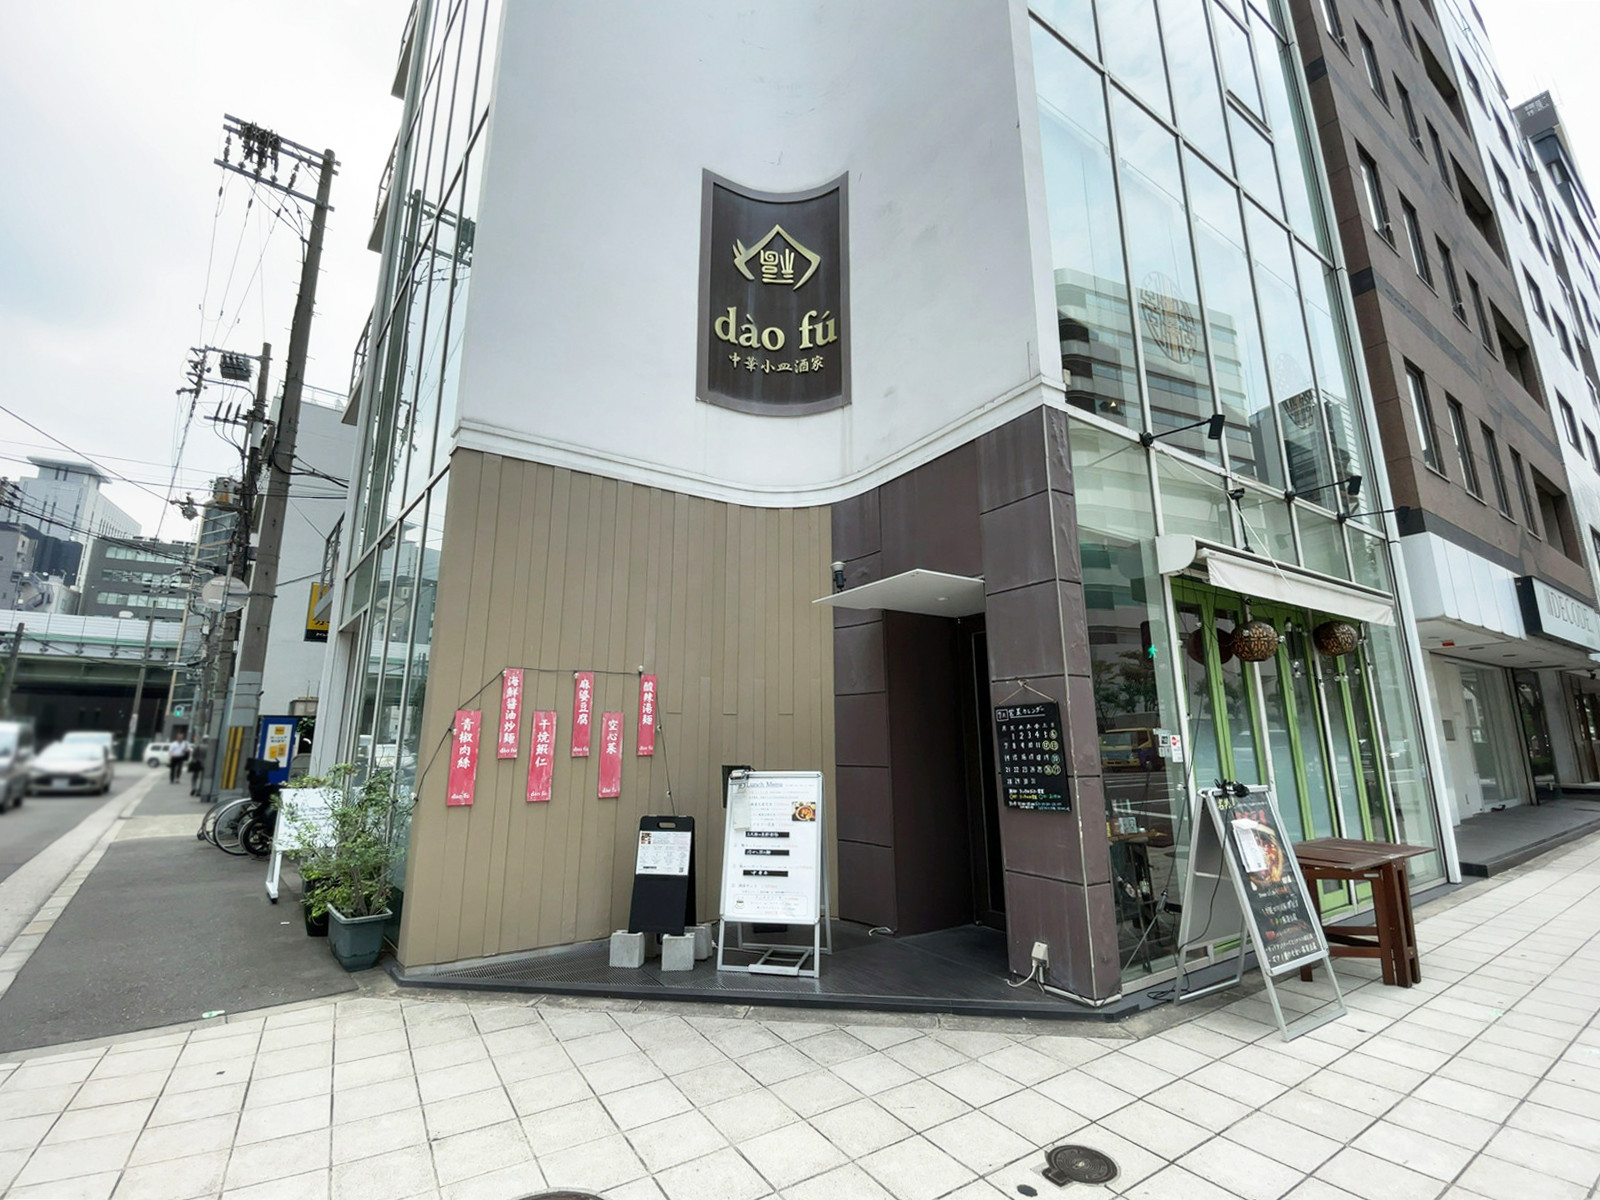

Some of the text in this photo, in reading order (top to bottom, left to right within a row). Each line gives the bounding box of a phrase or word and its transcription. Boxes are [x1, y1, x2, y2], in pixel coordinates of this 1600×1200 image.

[714, 306, 838, 351] dào fú
[728, 353, 824, 374] 中華小皿酒家
[577, 679, 591, 725] 麻婆豆腐
[606, 719, 619, 755] 空心菜
